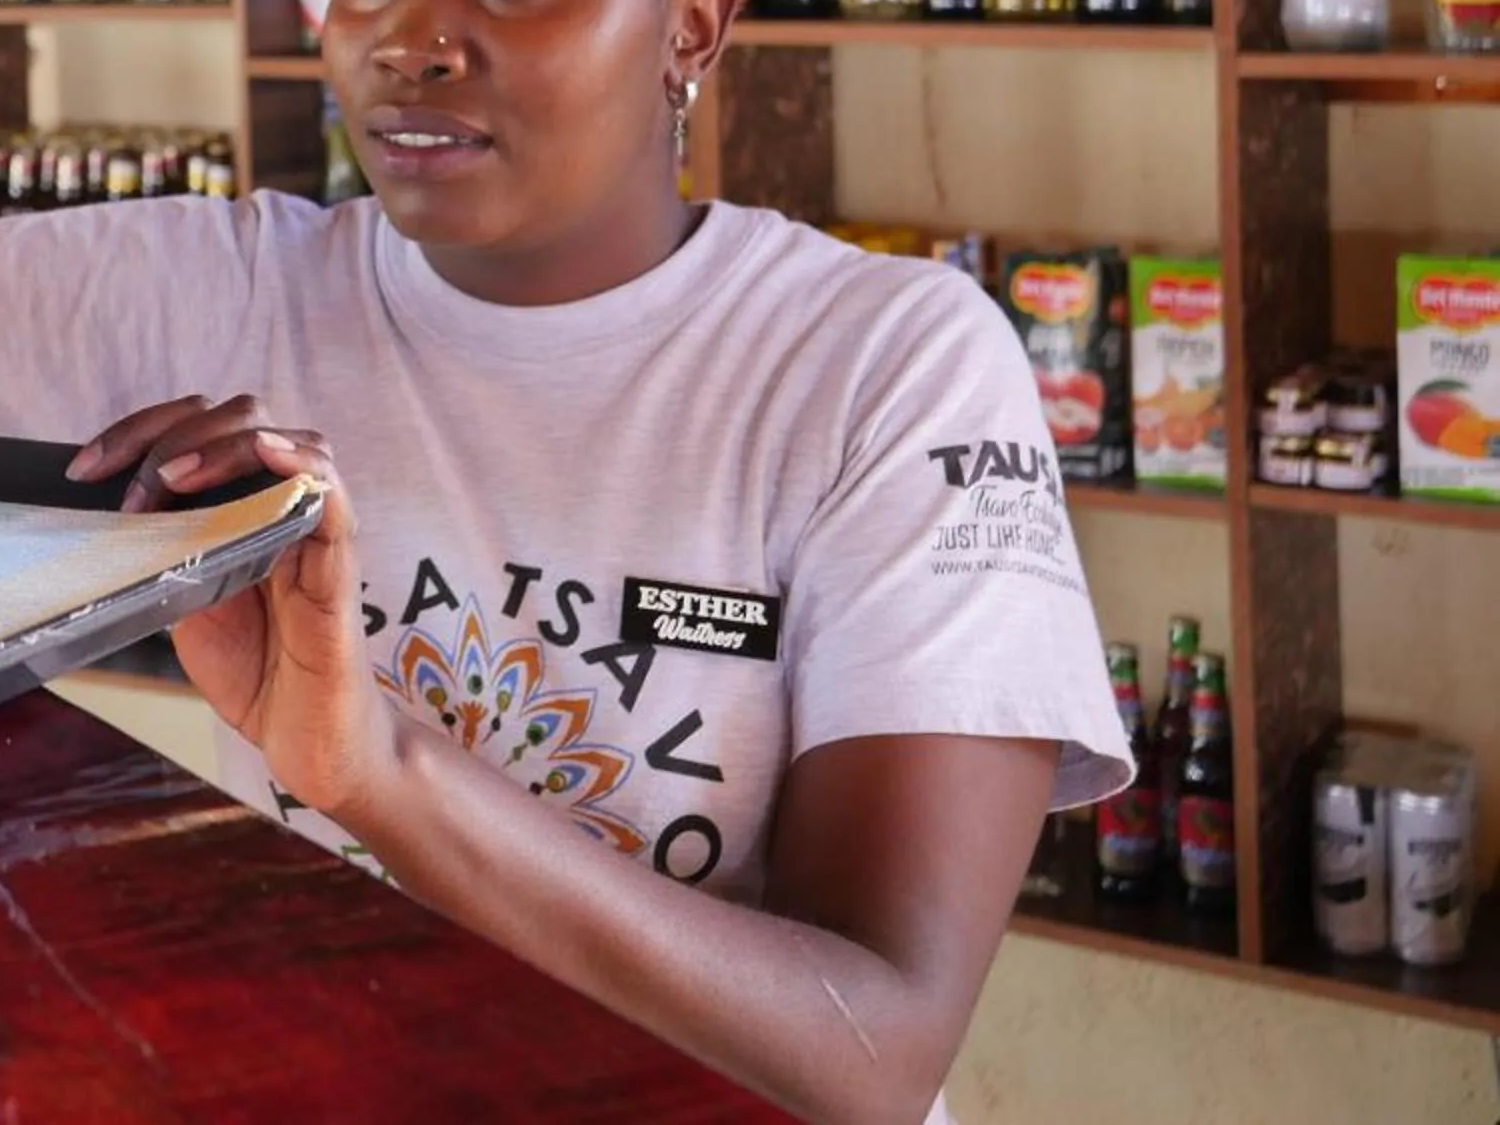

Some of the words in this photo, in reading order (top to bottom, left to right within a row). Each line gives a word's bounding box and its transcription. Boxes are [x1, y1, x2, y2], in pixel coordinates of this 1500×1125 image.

[932, 524, 979, 551] JUST
[637, 586, 768, 626] ESTHER
[653, 614, 746, 649] Waitress
